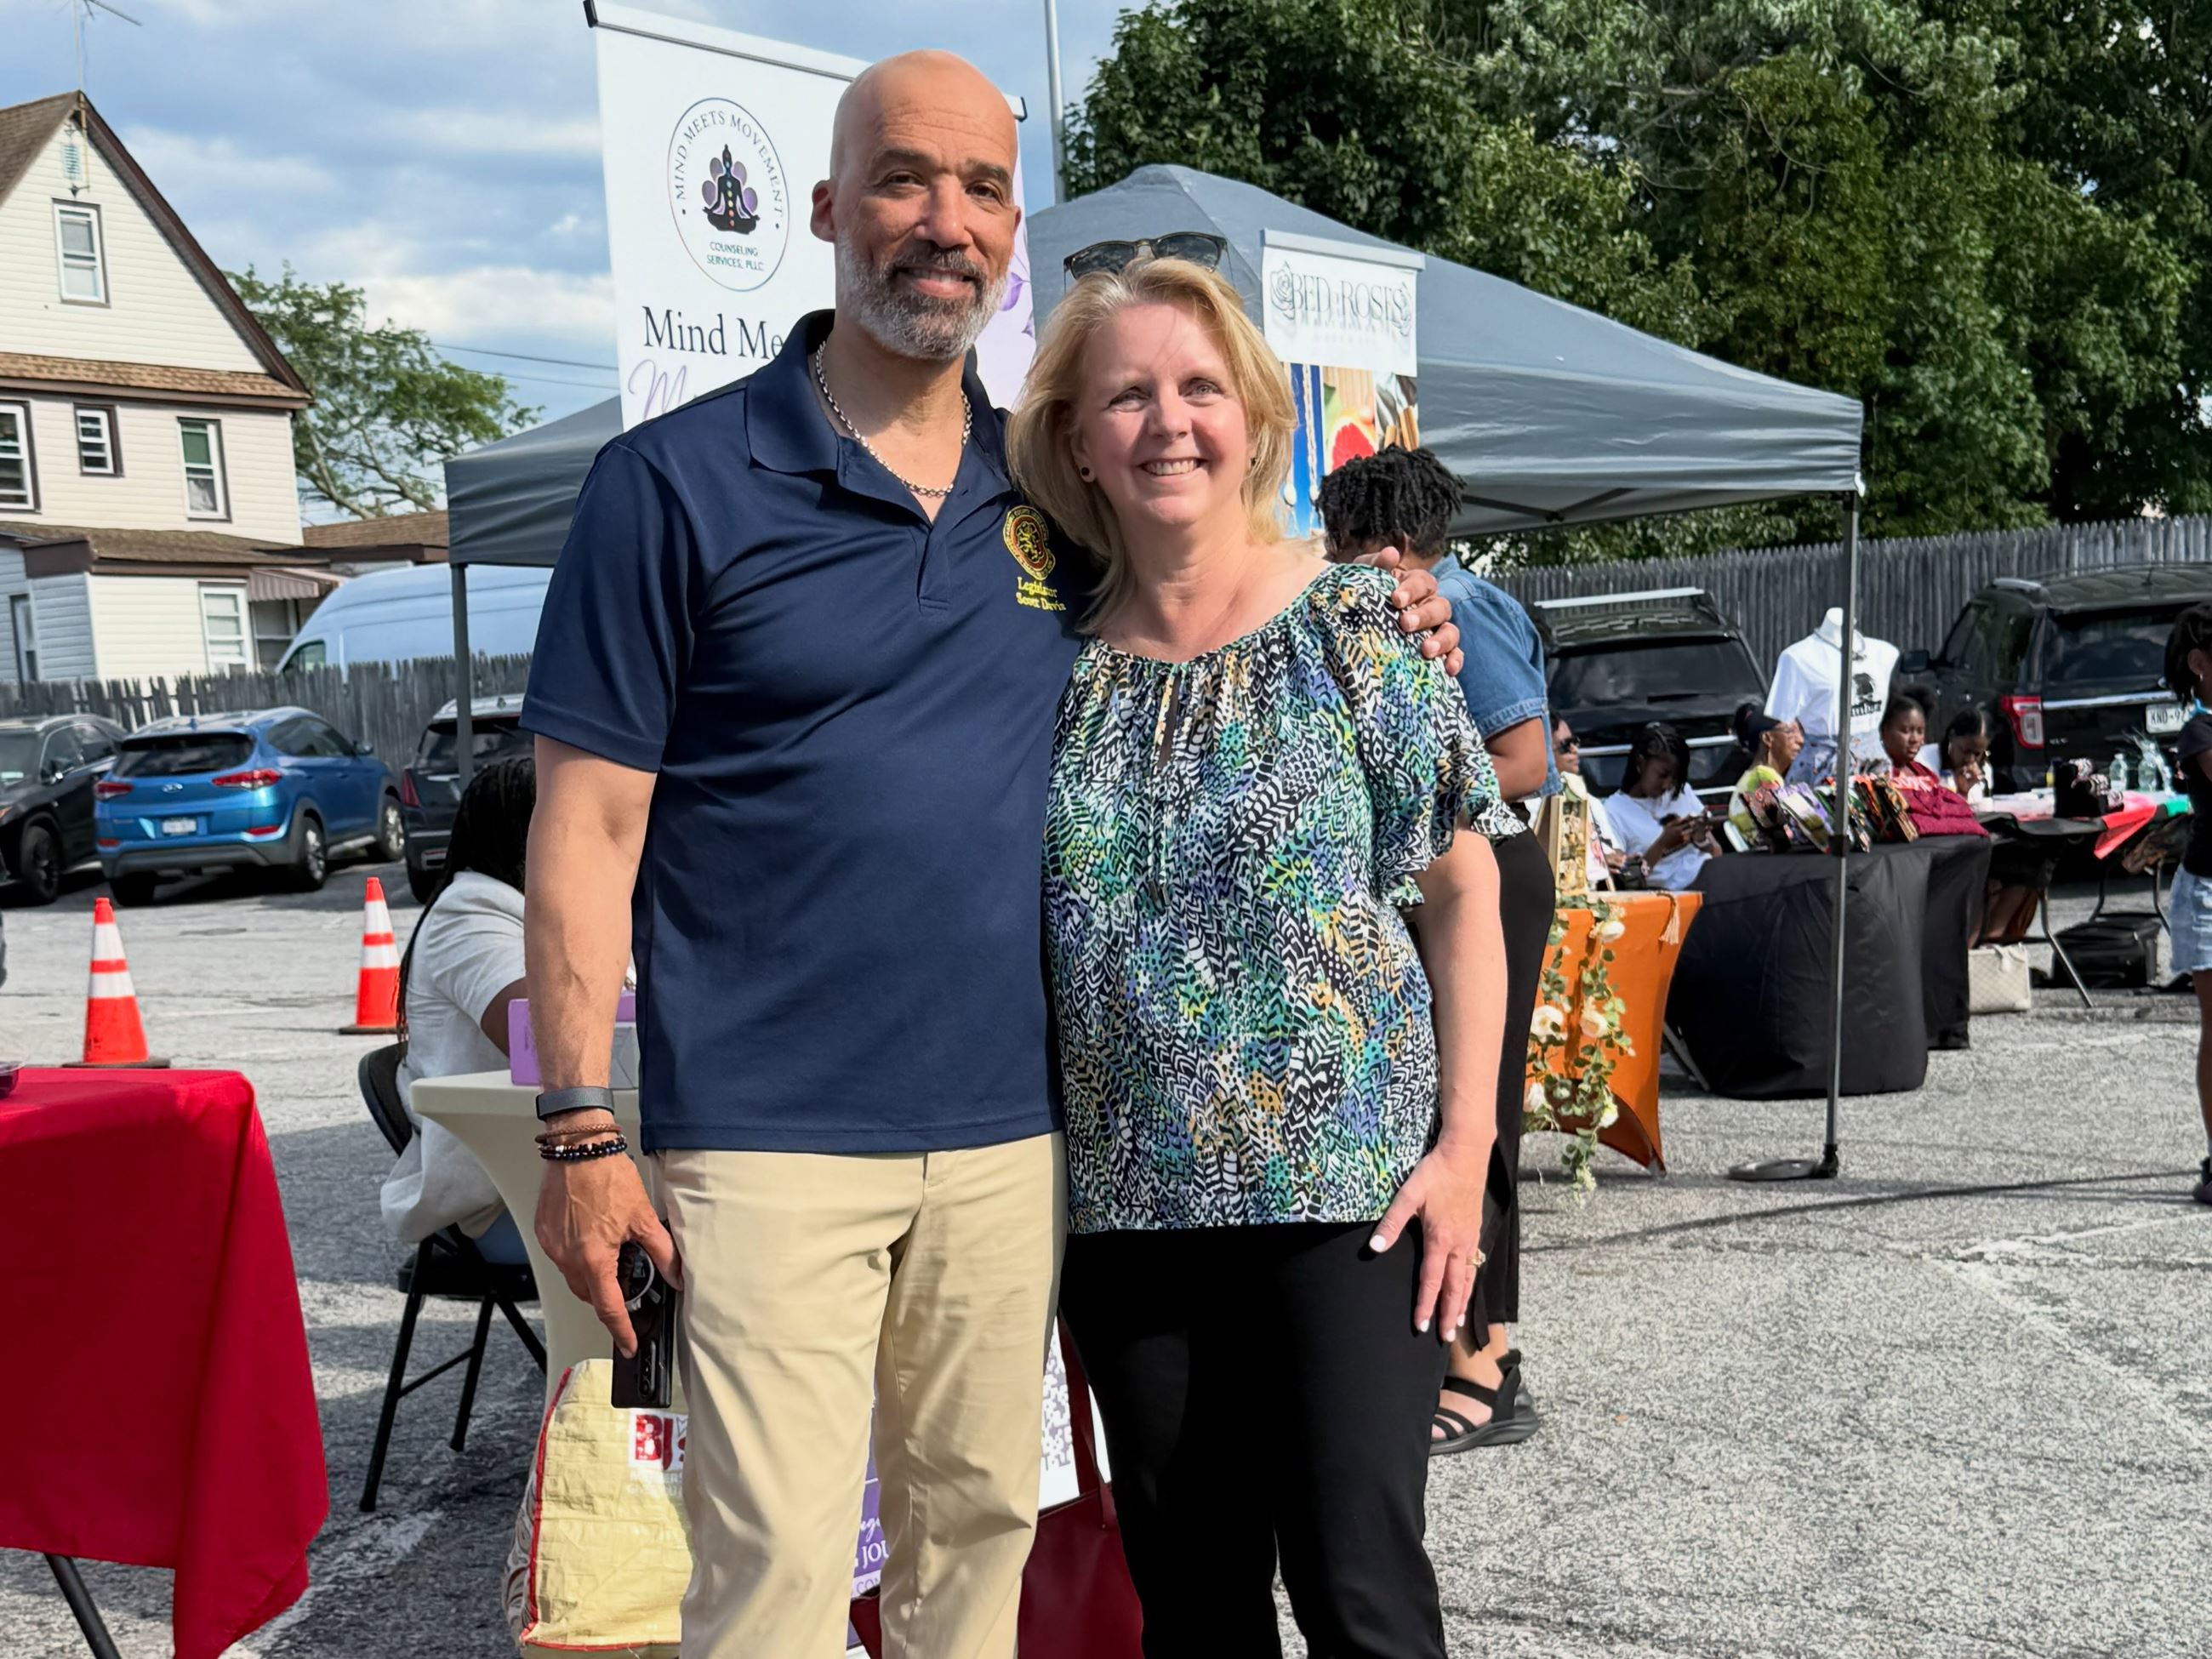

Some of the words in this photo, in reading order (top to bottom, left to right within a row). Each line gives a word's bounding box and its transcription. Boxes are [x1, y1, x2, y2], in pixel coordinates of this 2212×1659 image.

[674, 145, 687, 200] MIND
[683, 111, 726, 145] MEETS
[730, 114, 783, 218] MOVEMENT
[710, 241, 759, 257] COUNSELING
[745, 259, 764, 271] PLLC
[1291, 273, 1331, 312] BED
[642, 305, 727, 356] Mind
